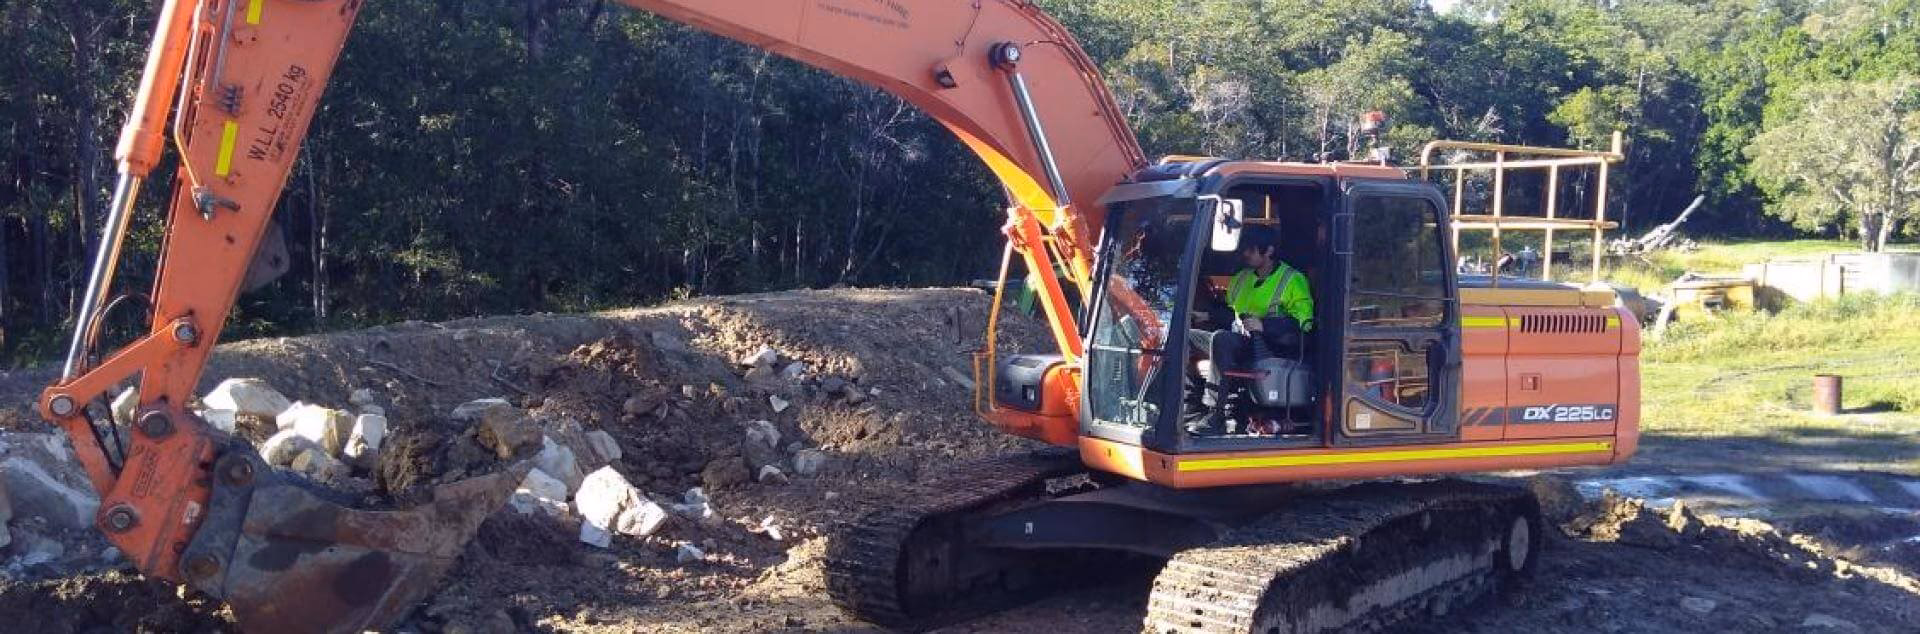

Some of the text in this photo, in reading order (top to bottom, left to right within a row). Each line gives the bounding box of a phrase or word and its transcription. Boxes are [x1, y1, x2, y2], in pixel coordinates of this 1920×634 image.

[267, 83, 295, 119] 2540
[283, 64, 306, 82] kg
[1554, 406, 1613, 422] 225LC
